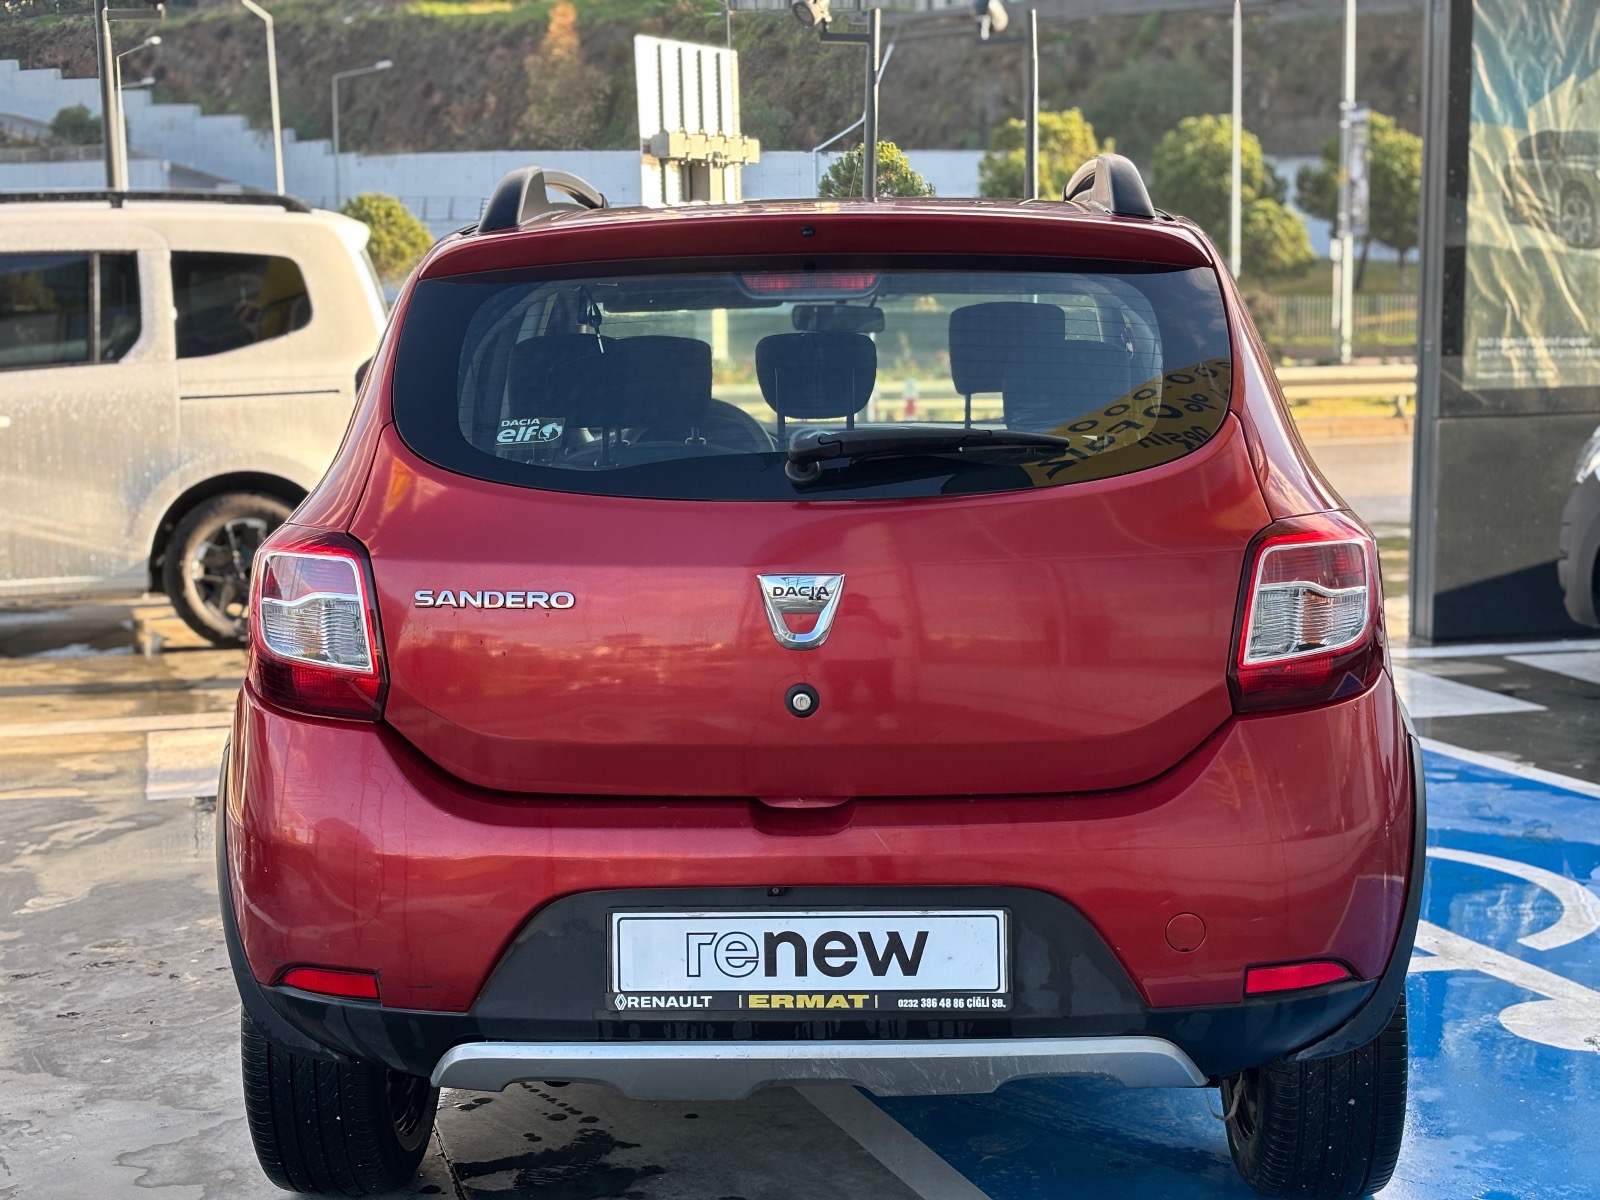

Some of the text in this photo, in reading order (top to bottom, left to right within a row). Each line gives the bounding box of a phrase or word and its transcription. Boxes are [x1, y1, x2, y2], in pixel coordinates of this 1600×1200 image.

[501, 418, 540, 427] DACIA
[496, 425, 540, 443] elf
[414, 590, 575, 609] SANDERO
[772, 586, 830, 597] DACIA
[686, 931, 930, 978] renew
[627, 995, 713, 1008] RENAULT
[748, 994, 870, 1008] ERMAT
[897, 999, 919, 1008] 0232
[920, 997, 938, 1008] 386
[938, 997, 952, 1008] 48
[953, 997, 965, 1008] 86
